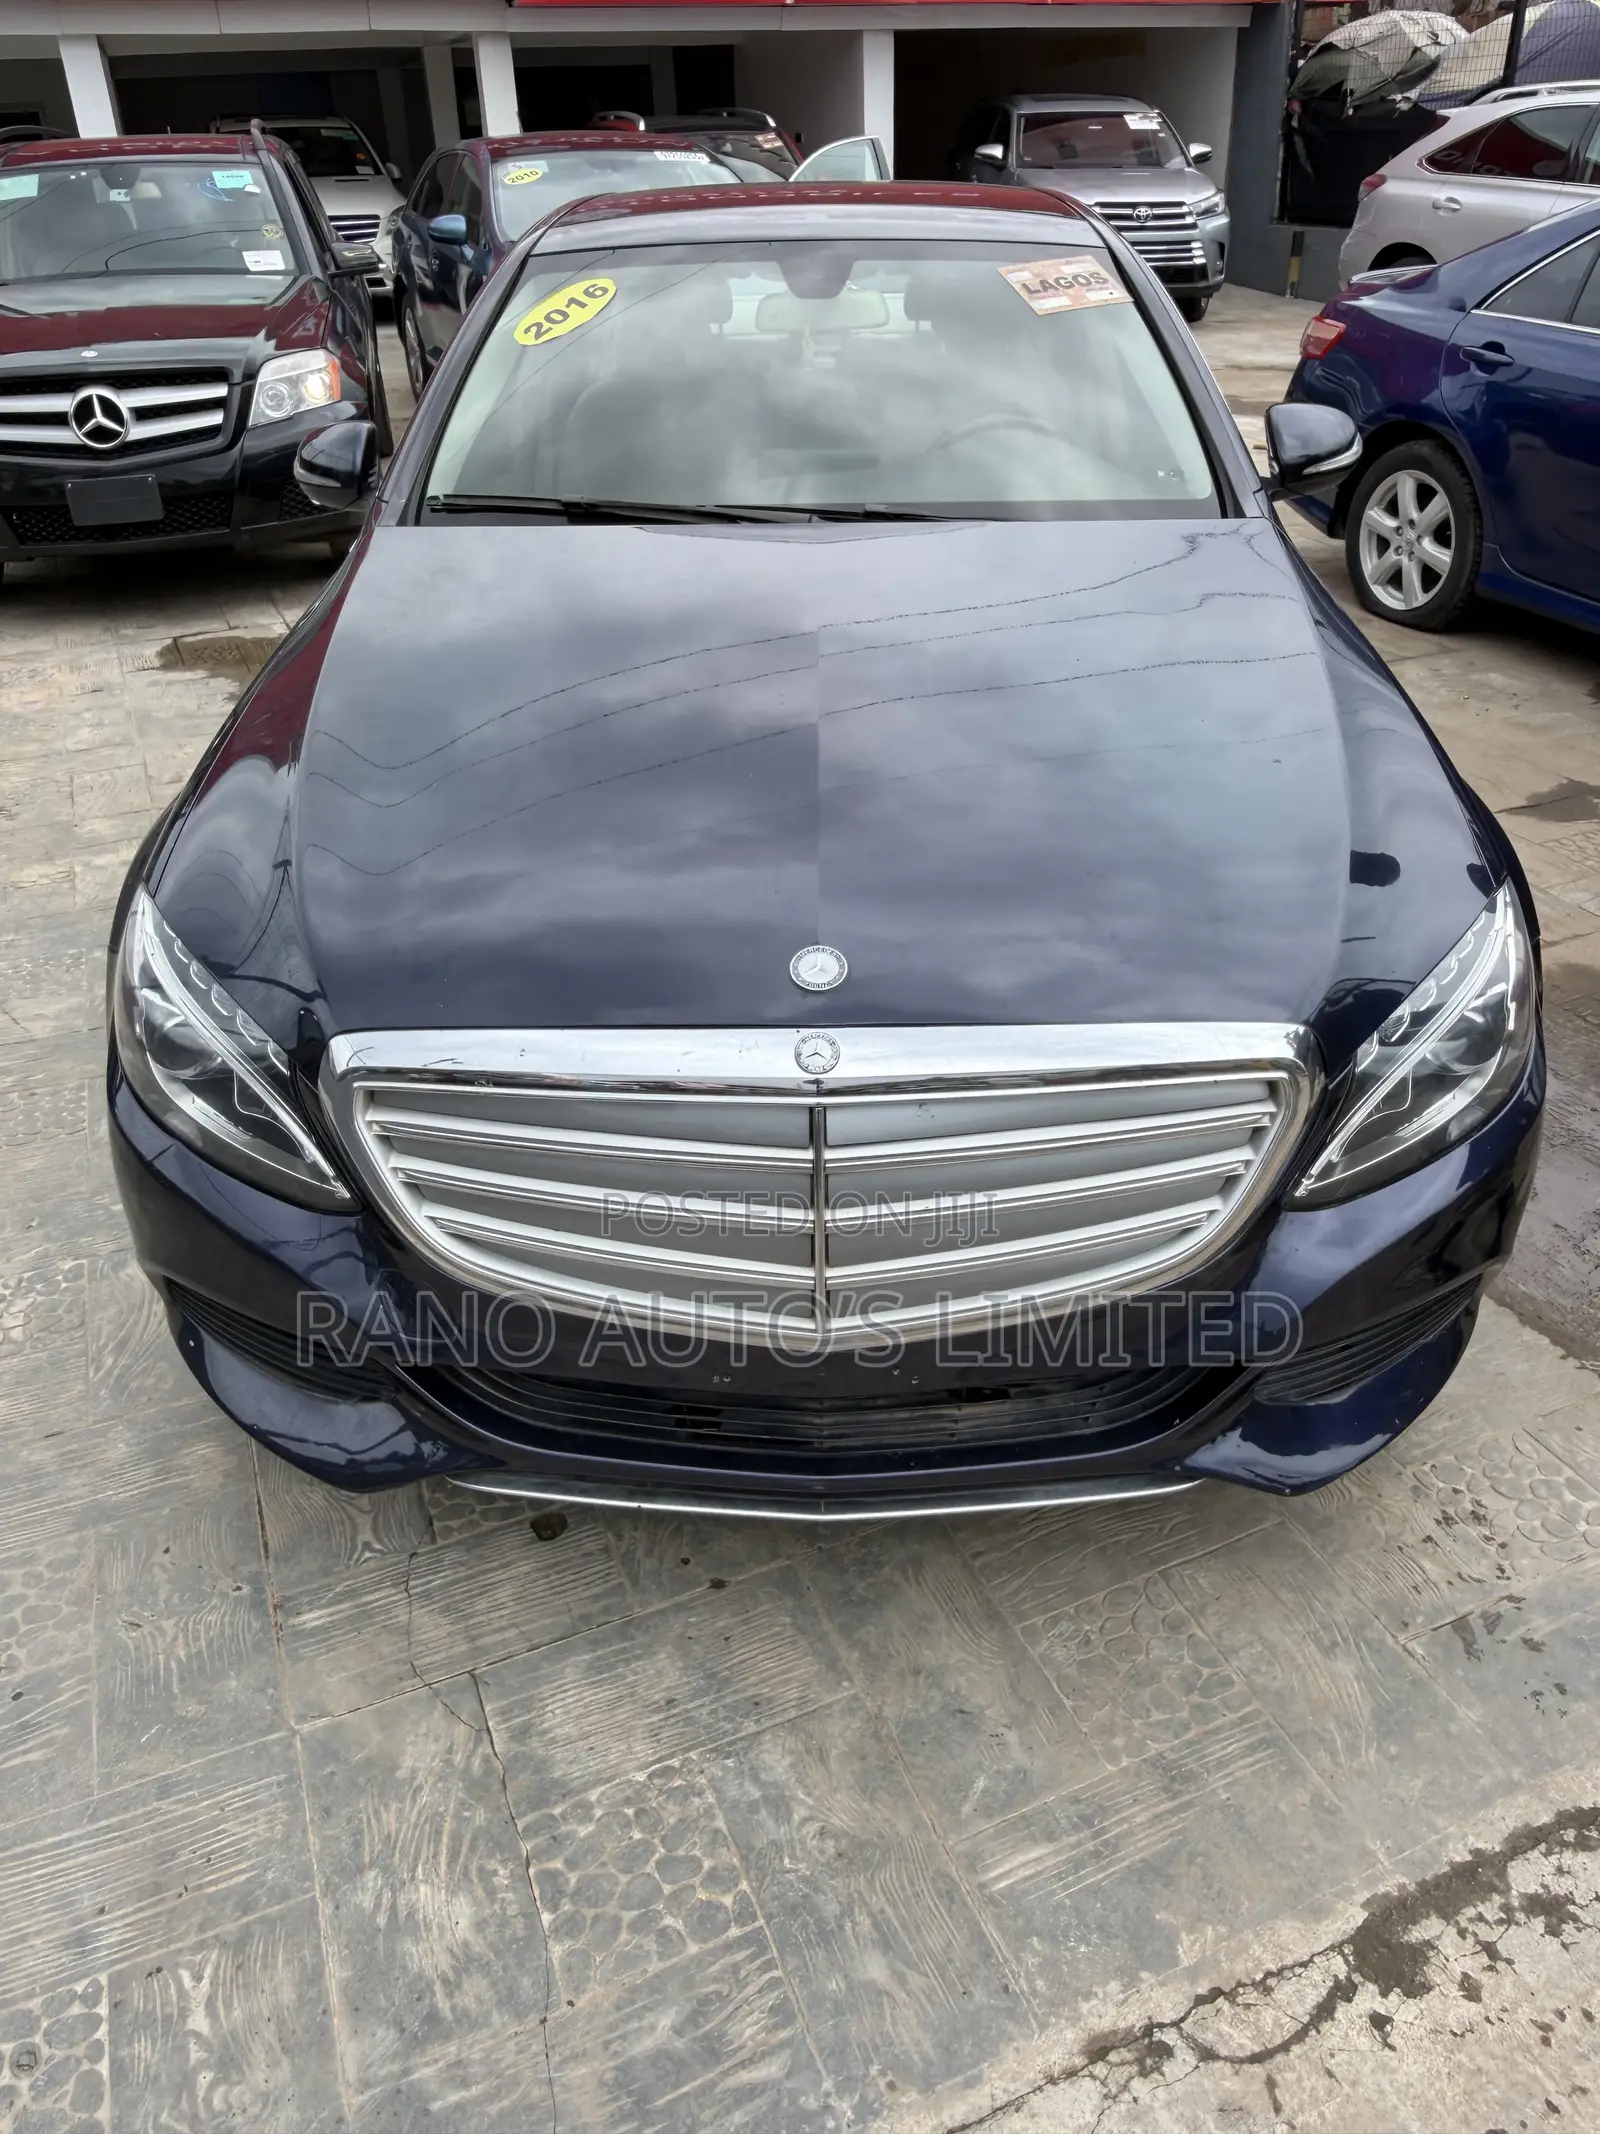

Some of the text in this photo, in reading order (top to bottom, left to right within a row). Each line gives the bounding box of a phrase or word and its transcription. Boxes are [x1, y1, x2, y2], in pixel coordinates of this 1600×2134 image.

[507, 170, 539, 184] 2010
[1021, 271, 1109, 294] LAGOS
[523, 283, 610, 341] 2016
